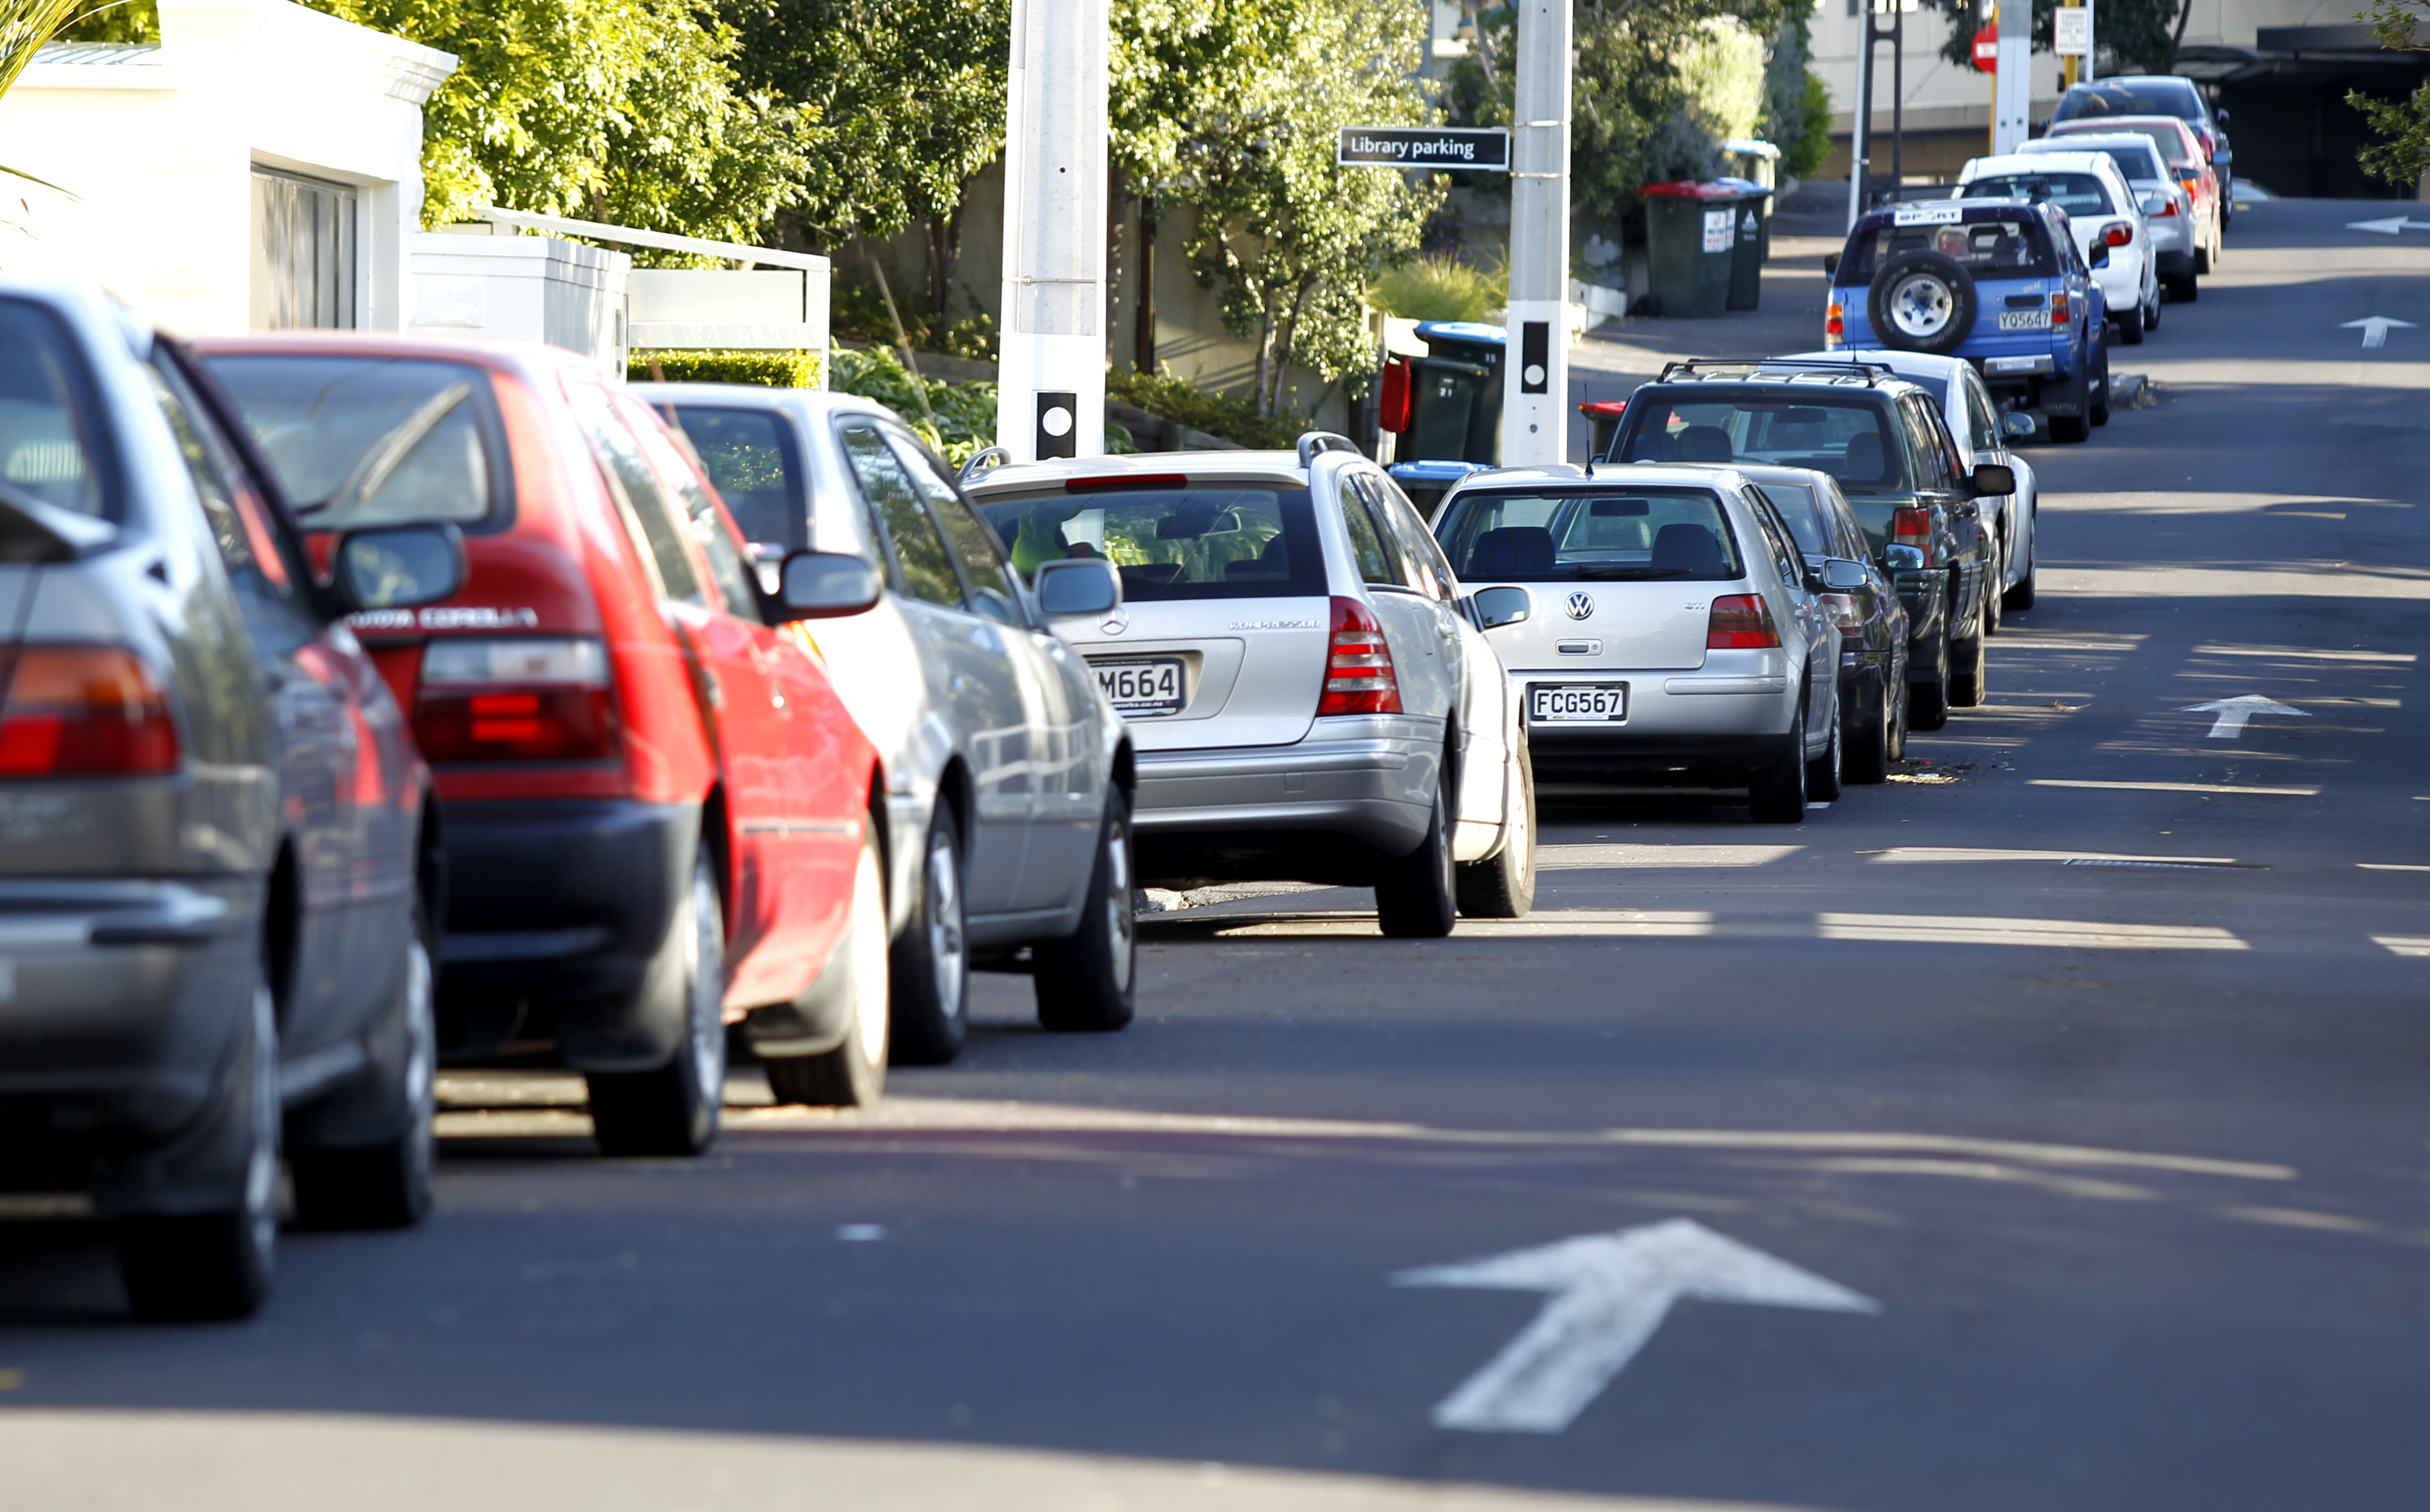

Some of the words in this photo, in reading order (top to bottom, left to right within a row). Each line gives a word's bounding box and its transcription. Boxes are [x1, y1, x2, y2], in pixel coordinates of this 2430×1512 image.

[1351, 137, 1408, 158] Library
[1412, 138, 1474, 160] parking
[344, 608, 415, 629] OYOTA
[1229, 620, 1321, 630] KOMPRESSOR
[1098, 669, 1174, 698] M664
[1537, 693, 1619, 713] FCG567
